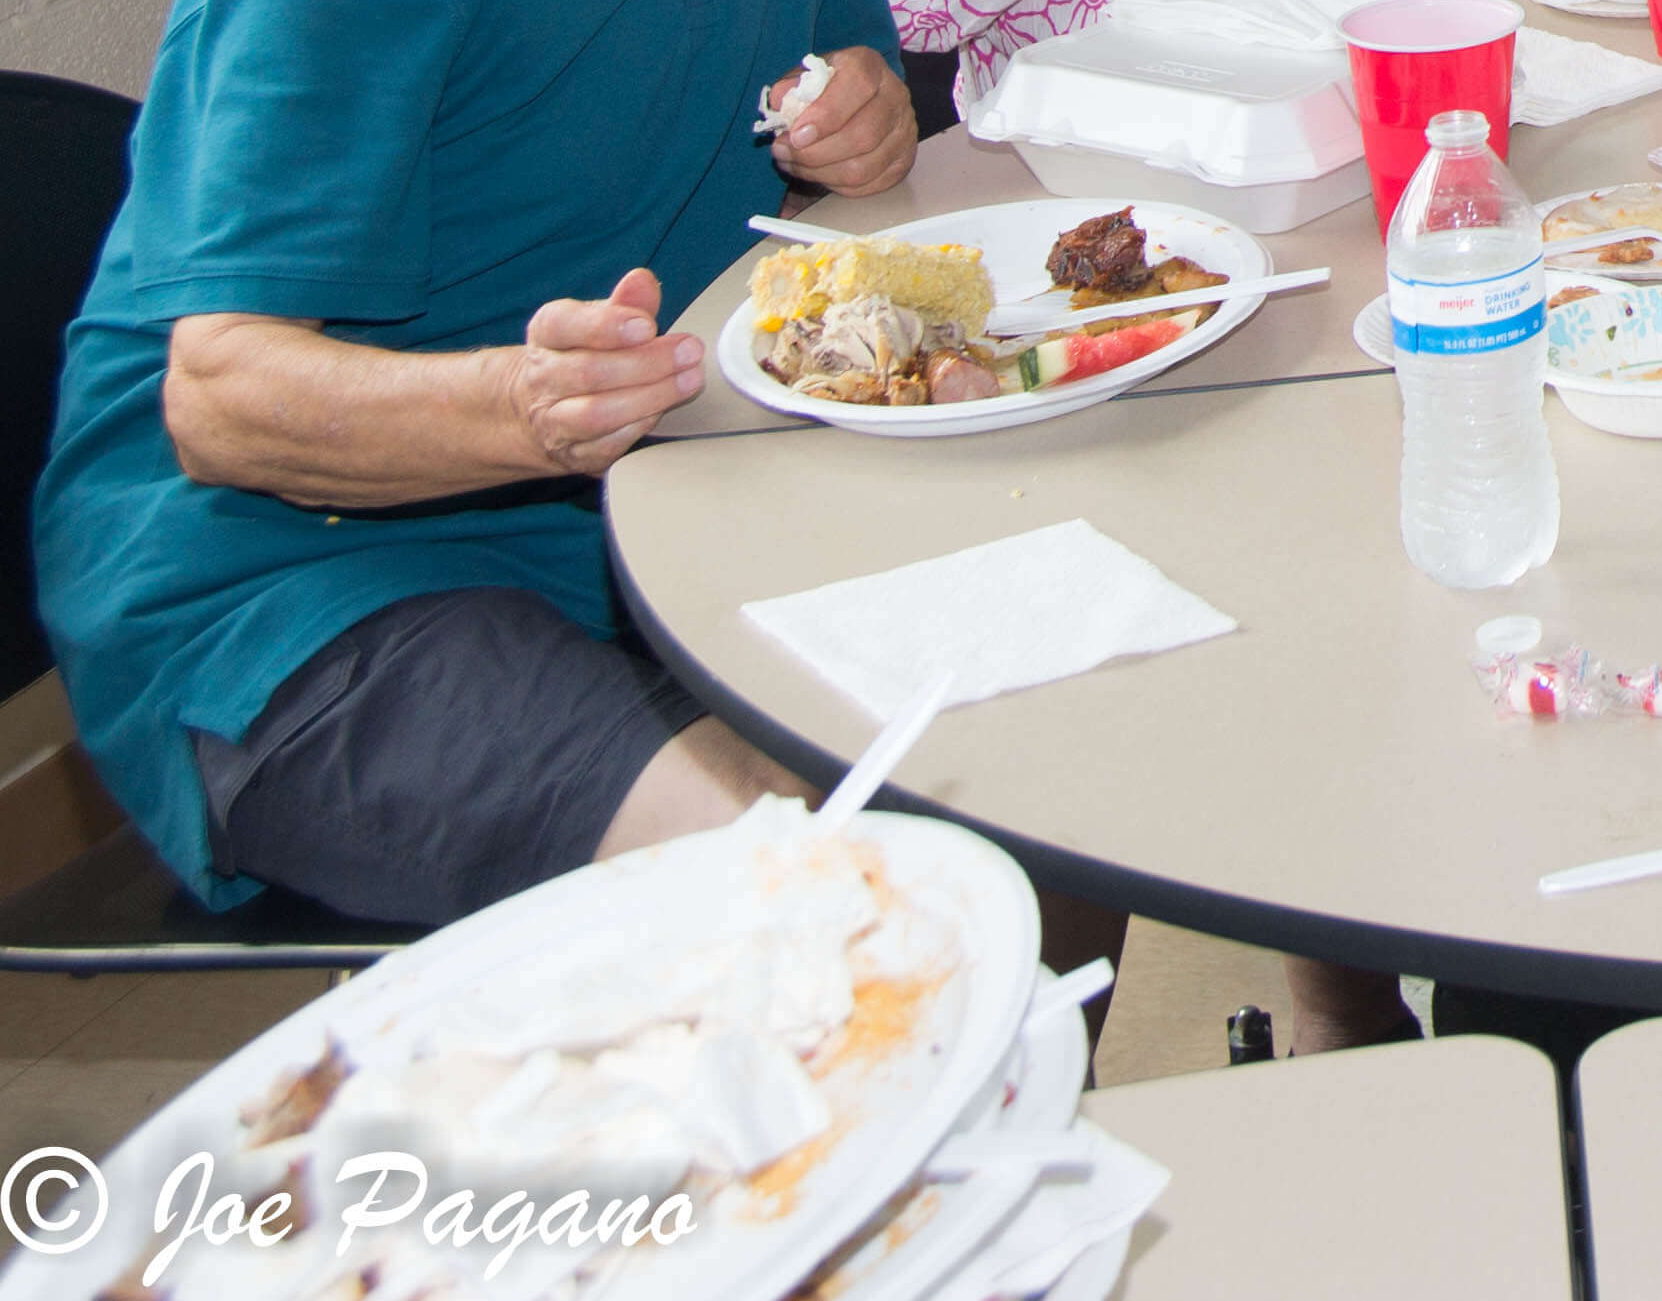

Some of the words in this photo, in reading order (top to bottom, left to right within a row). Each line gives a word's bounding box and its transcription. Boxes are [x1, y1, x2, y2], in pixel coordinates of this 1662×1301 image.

[1484, 282, 1530, 304] DRINKING
[1439, 297, 1474, 311] meijer
[1486, 298, 1520, 315] WATER
